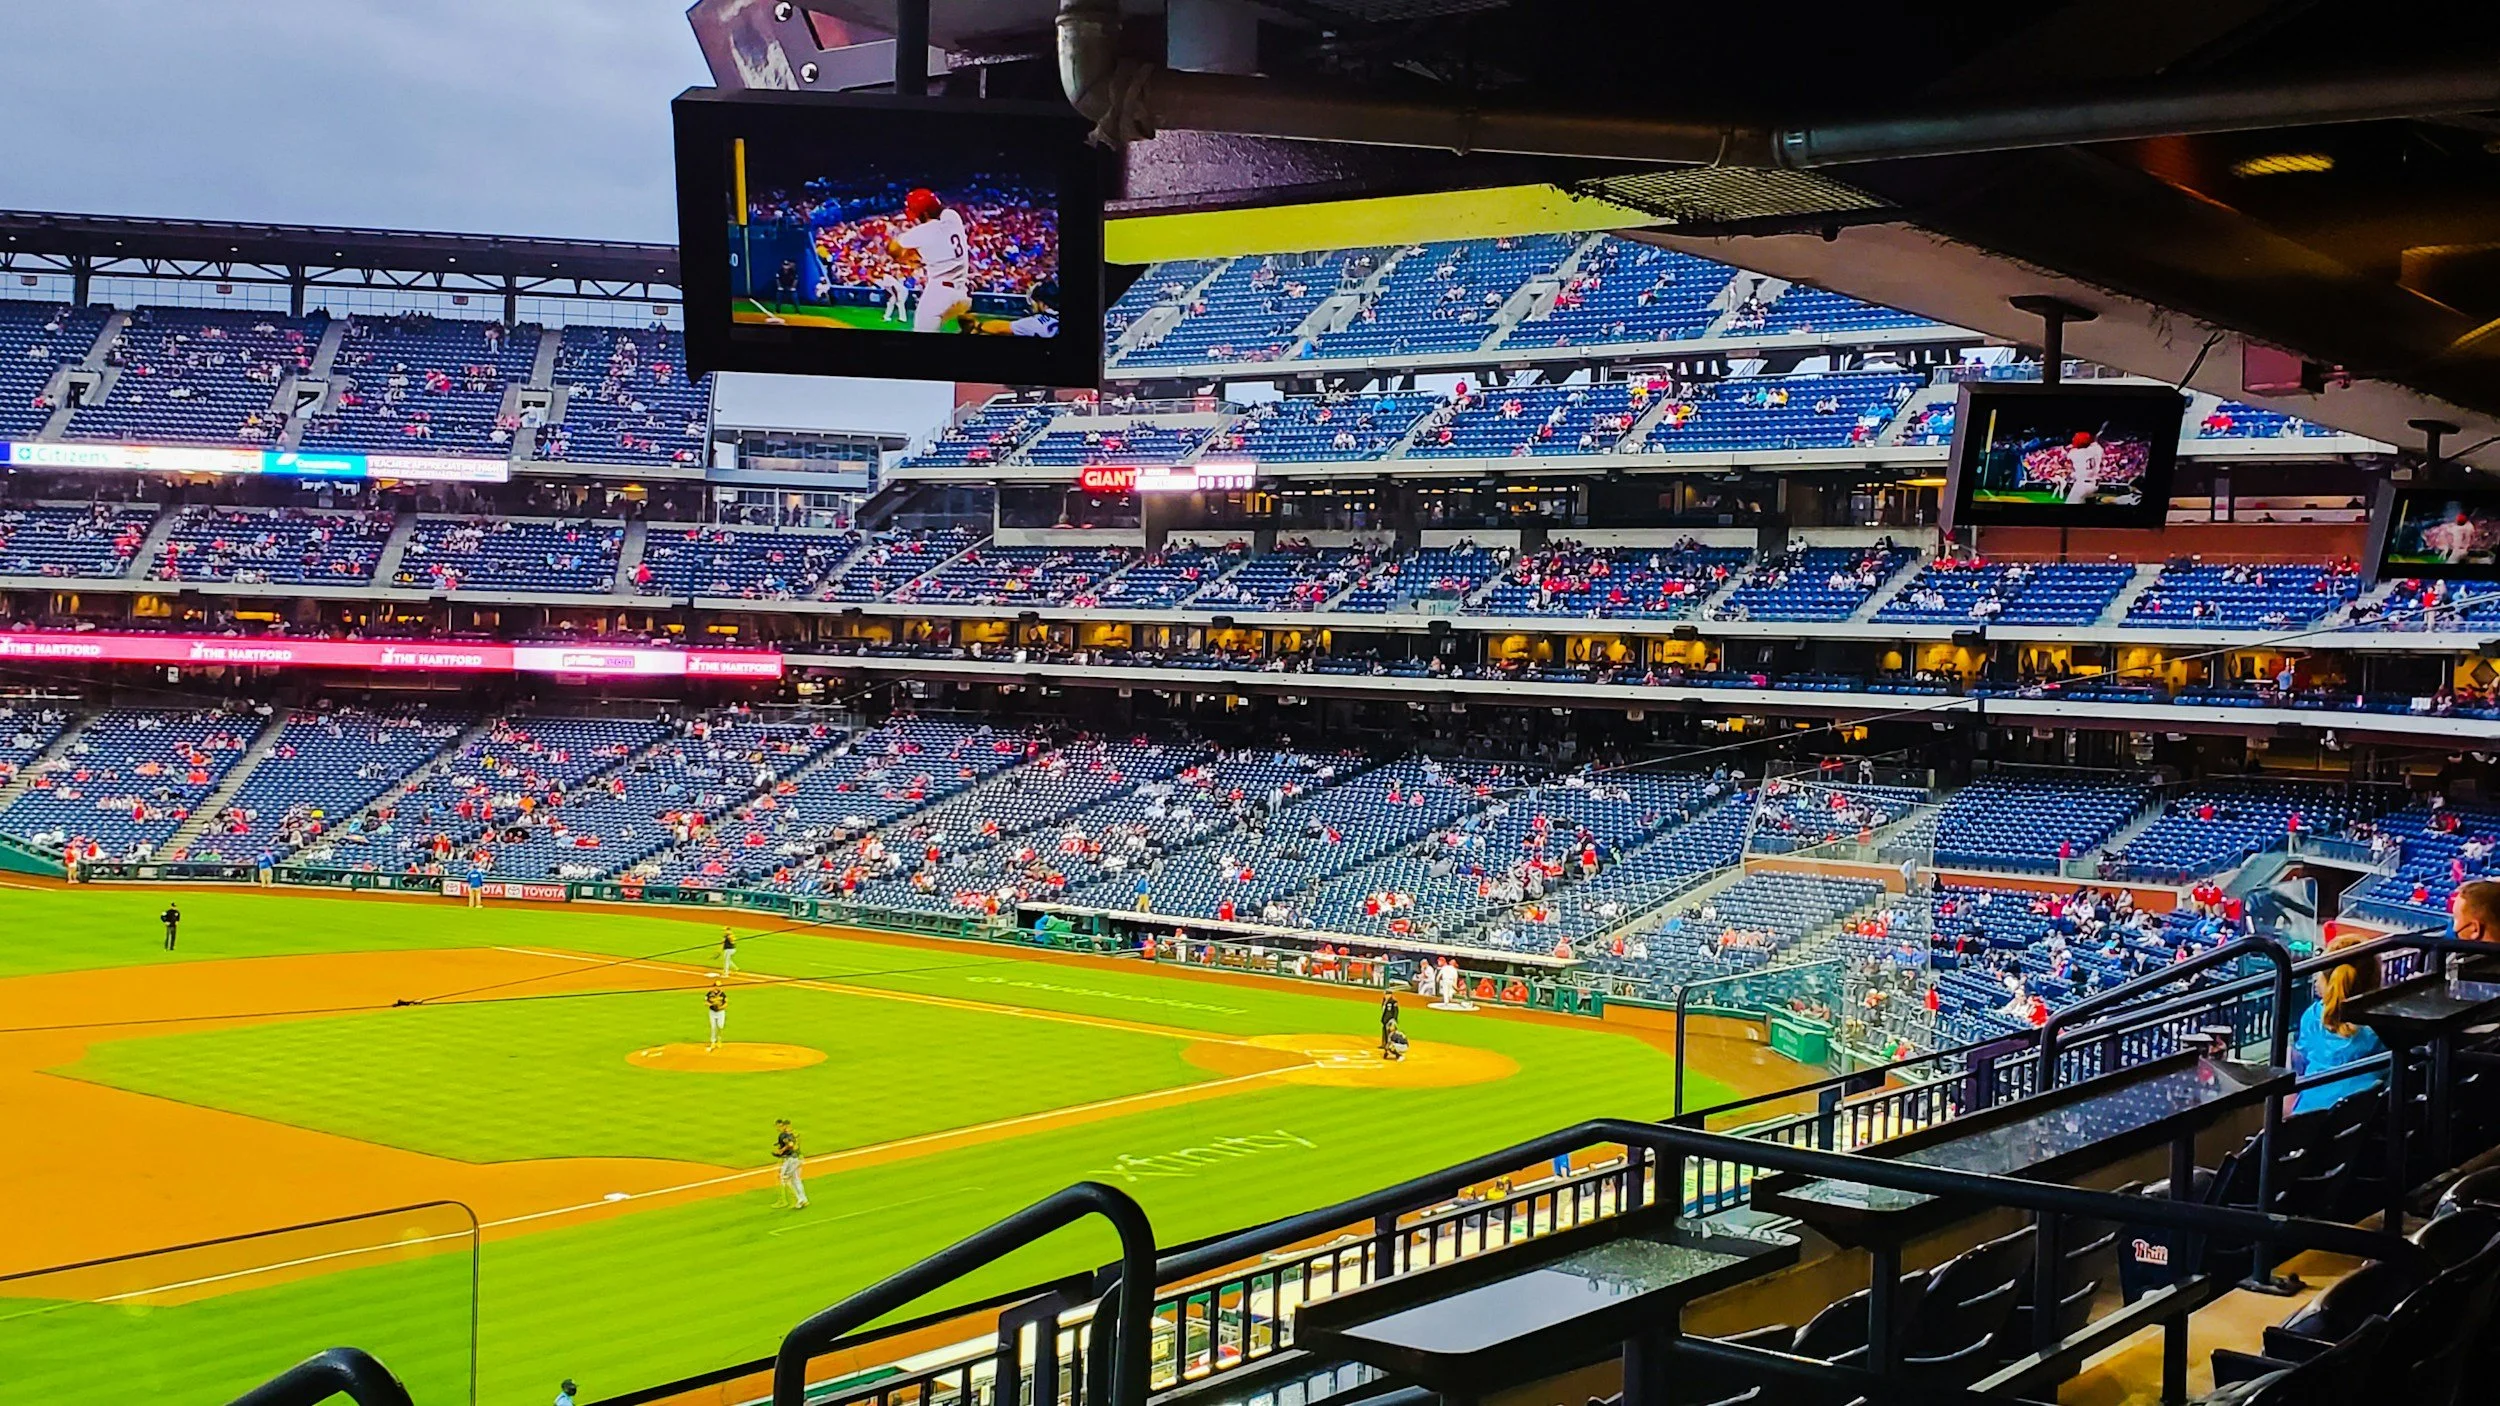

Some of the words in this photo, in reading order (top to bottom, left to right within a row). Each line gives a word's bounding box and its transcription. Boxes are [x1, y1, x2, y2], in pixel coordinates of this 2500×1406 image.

[950, 234, 963, 258] 3
[37, 447, 109, 463] Citizens
[1084, 470, 1136, 487] GIANT
[9, 643, 32, 654] THE
[36, 644, 100, 656] HARTFORD
[202, 648, 225, 659] THE
[229, 649, 292, 661] HARTFORD
[394, 653, 415, 664] THE
[419, 654, 482, 666] HARTFORD
[700, 661, 720, 671] THE
[722, 662, 777, 673] HARTFORD
[523, 886, 566, 899] TOYOTA
